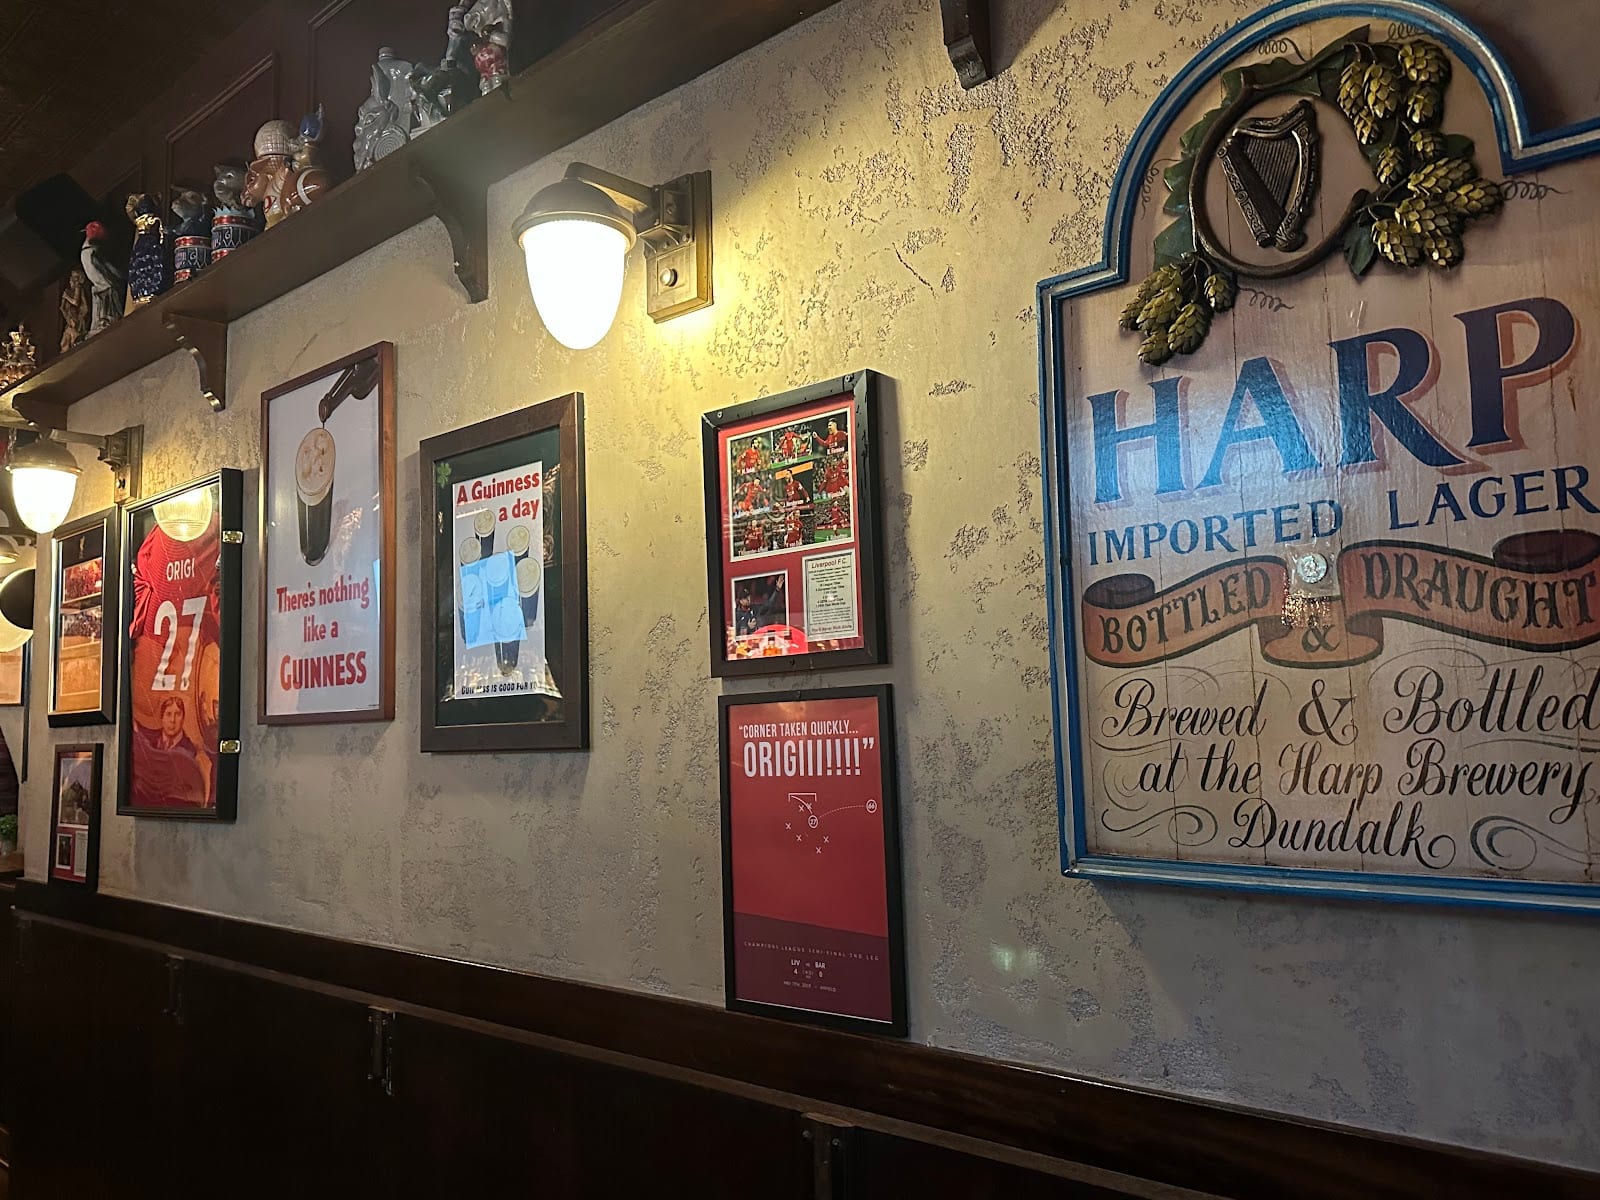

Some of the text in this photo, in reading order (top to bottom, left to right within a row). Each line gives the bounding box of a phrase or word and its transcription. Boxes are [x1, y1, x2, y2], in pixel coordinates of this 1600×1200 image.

[1087, 297, 1579, 506] HARP
[456, 471, 540, 505] A Guinness
[498, 498, 540, 522] a day
[1088, 465, 1600, 566] IMPORTED LAGER
[166, 557, 196, 582] ORIGI
[811, 560, 837, 569] Liverpool
[276, 574, 370, 614] There's nothing
[1101, 552, 1597, 654] BOTTLED DRAUGHT
[150, 596, 208, 691] 27
[303, 614, 339, 643] like a
[1301, 613, 1341, 653] &
[280, 651, 367, 691] GUINNESS
[491, 684, 498, 693] IS
[499, 683, 515, 692] GOOD
[1101, 664, 1600, 746] Brewed & Bottled
[779, 722, 808, 737] TAKEN
[810, 720, 859, 736] QUICKLY...
[1138, 739, 1191, 794] at
[1197, 739, 1262, 795] the
[1278, 742, 1384, 812] Harp
[1228, 796, 1456, 870] Dundalk
[743, 941, 779, 950] CHAMPIONS
[781, 945, 805, 953] LEAGUE
[815, 961, 826, 969] BAR
